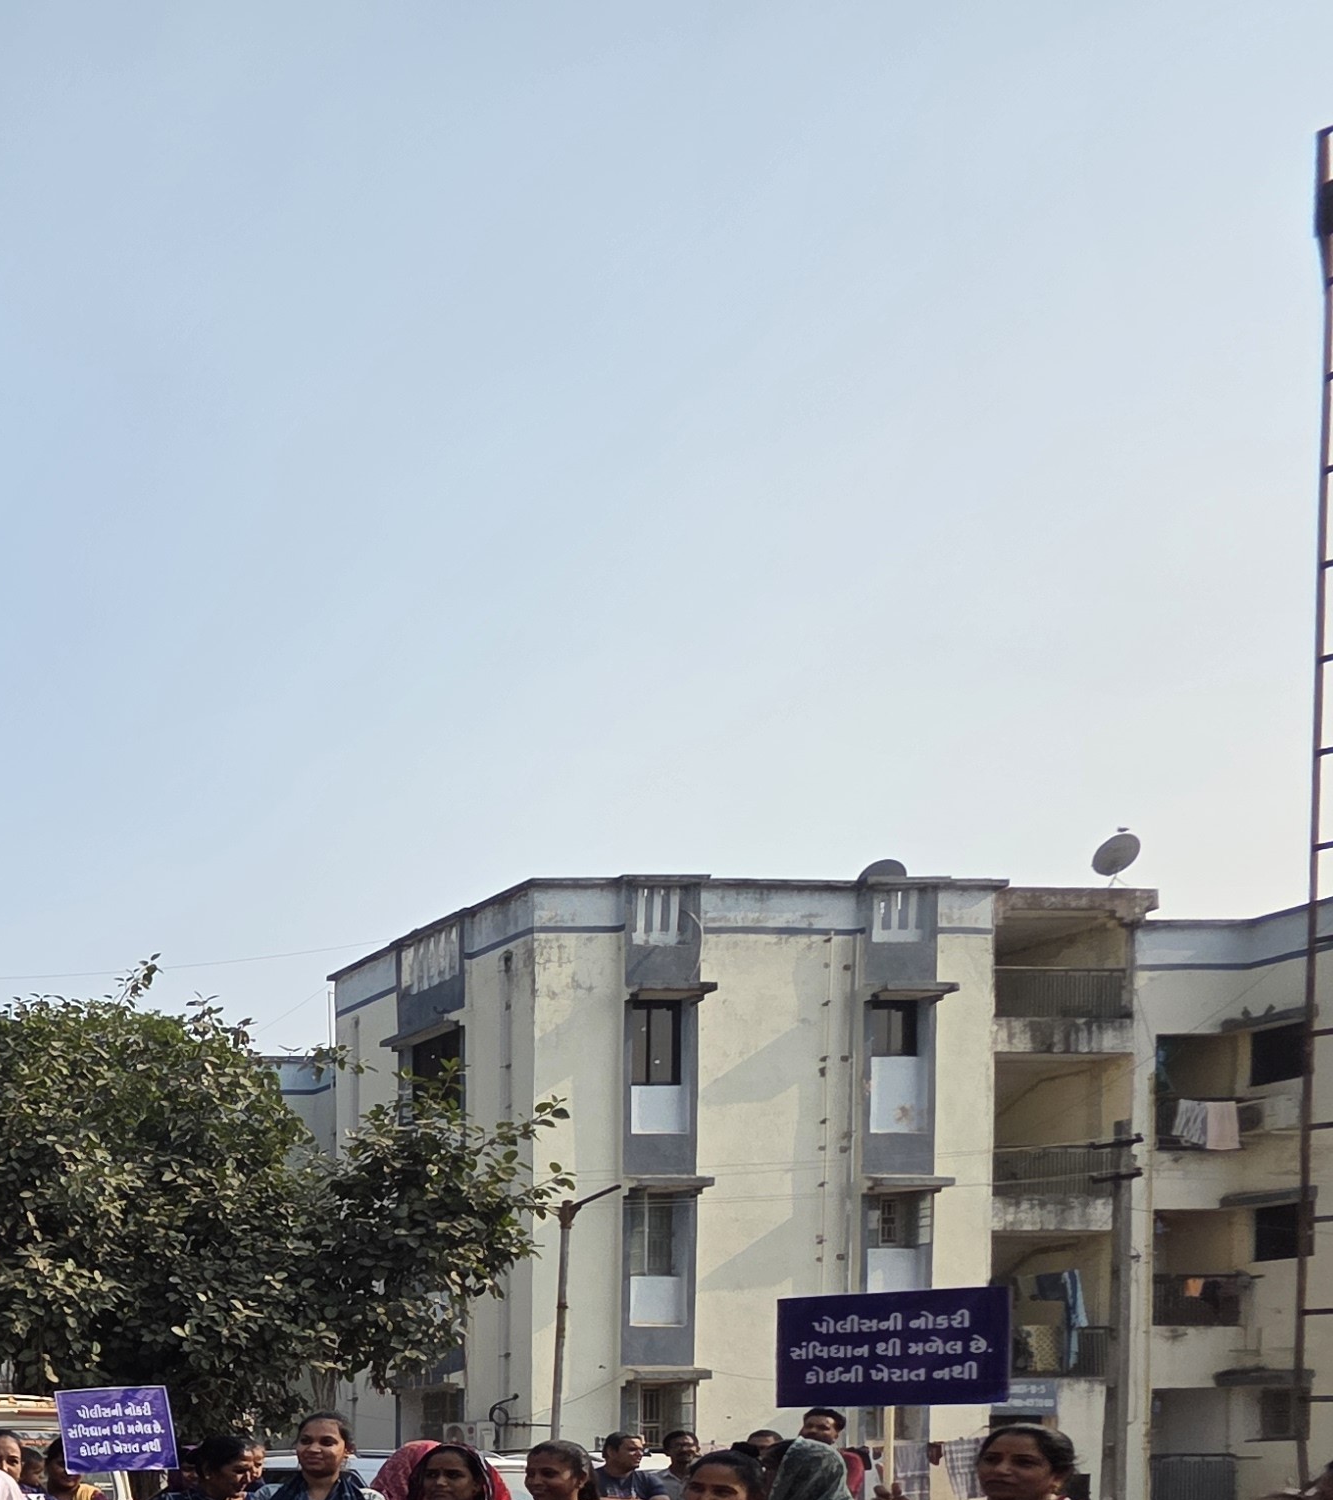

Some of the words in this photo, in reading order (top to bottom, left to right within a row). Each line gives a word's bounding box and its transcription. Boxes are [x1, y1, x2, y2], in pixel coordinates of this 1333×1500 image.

[812, 1312, 902, 1334] પોલીસની
[909, 1309, 970, 1330] નોકરી
[790, 1341, 869, 1360] સંવિધાન
[875, 1338, 901, 1357] થી
[908, 1336, 962, 1356] મળેલ
[969, 1334, 993, 1353] છે.
[805, 1365, 863, 1384] કોઈની
[869, 1364, 926, 1382] ખેરાત
[932, 1361, 977, 1380] નથી
